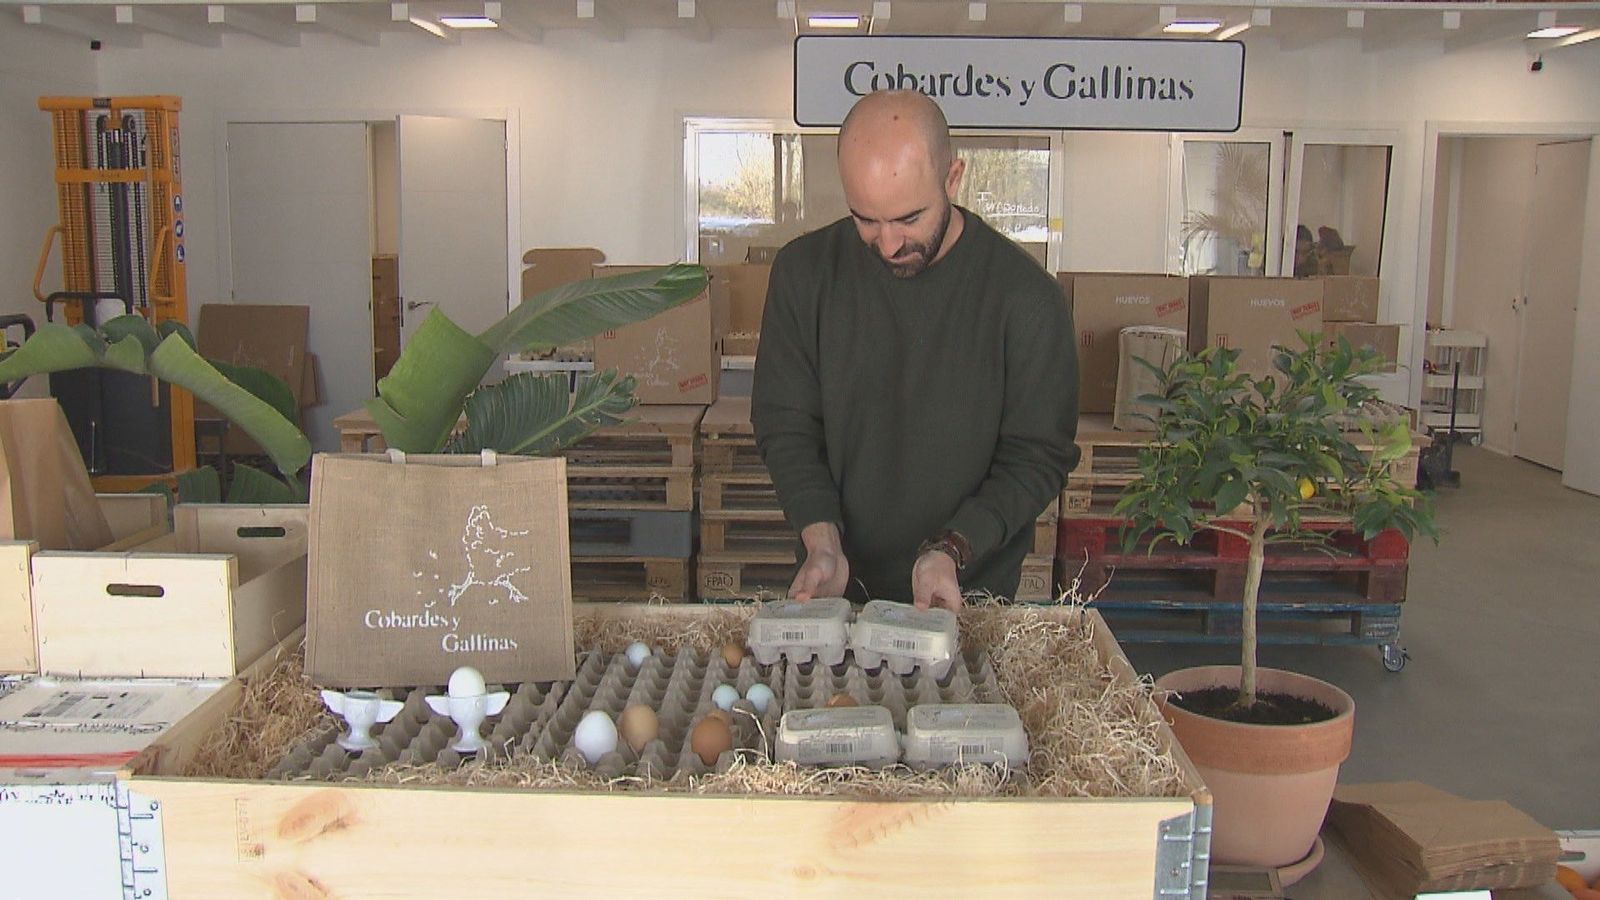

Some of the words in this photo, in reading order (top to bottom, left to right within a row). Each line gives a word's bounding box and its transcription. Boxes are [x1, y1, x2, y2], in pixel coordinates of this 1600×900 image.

[843, 61, 1011, 100] Cobardes
[1019, 79, 1036, 106] y
[1043, 62, 1194, 101] Gallinas
[365, 609, 449, 629] Cobardes
[452, 616, 461, 631] y
[441, 633, 518, 653] Gallinas
